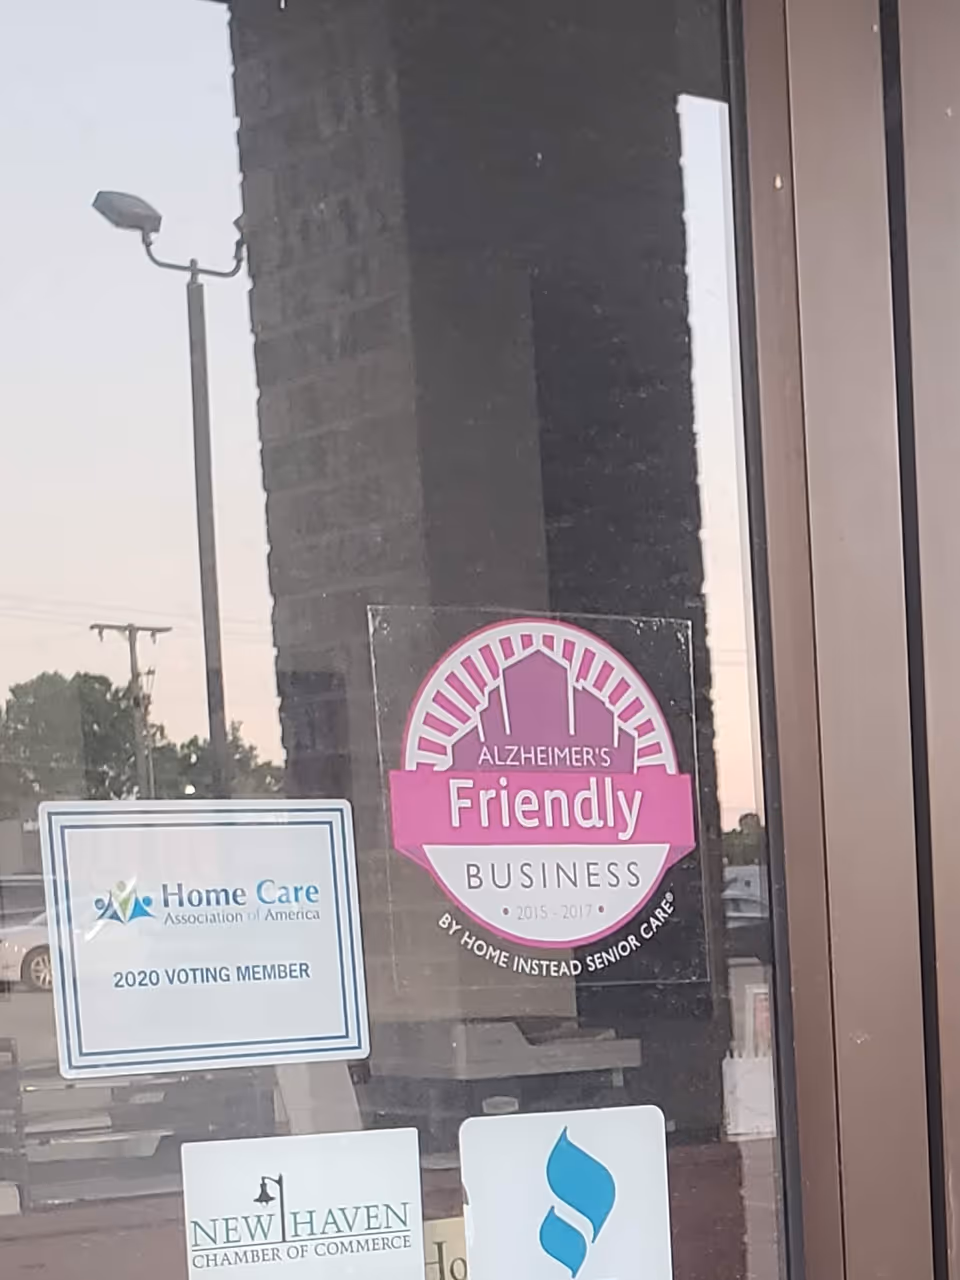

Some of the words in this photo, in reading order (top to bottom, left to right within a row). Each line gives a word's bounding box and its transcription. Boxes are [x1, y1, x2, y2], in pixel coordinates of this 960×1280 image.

[477, 745, 611, 767] ALZHEIMER'S
[449, 776, 643, 841] Friendly
[465, 861, 641, 891] BUSINESS
[162, 883, 247, 908] Home
[256, 879, 320, 904] Care
[164, 911, 243, 926] Association
[265, 908, 320, 921] America
[517, 904, 548, 921] 2015
[562, 902, 593, 919] 2017
[438, 912, 462, 936] BY
[460, 931, 510, 969] HOME
[512, 955, 582, 978] INSTEAD
[585, 934, 642, 972] SENIOR
[113, 968, 160, 988] 2020
[165, 965, 231, 986] VOTING
[236, 962, 312, 983] MEMBER
[190, 1213, 275, 1247] NEW
[290, 1202, 410, 1238] HAVEN
[192, 1247, 282, 1269] CHAMBER
[286, 1244, 309, 1260] OF
[314, 1235, 412, 1257] COMMERCE
